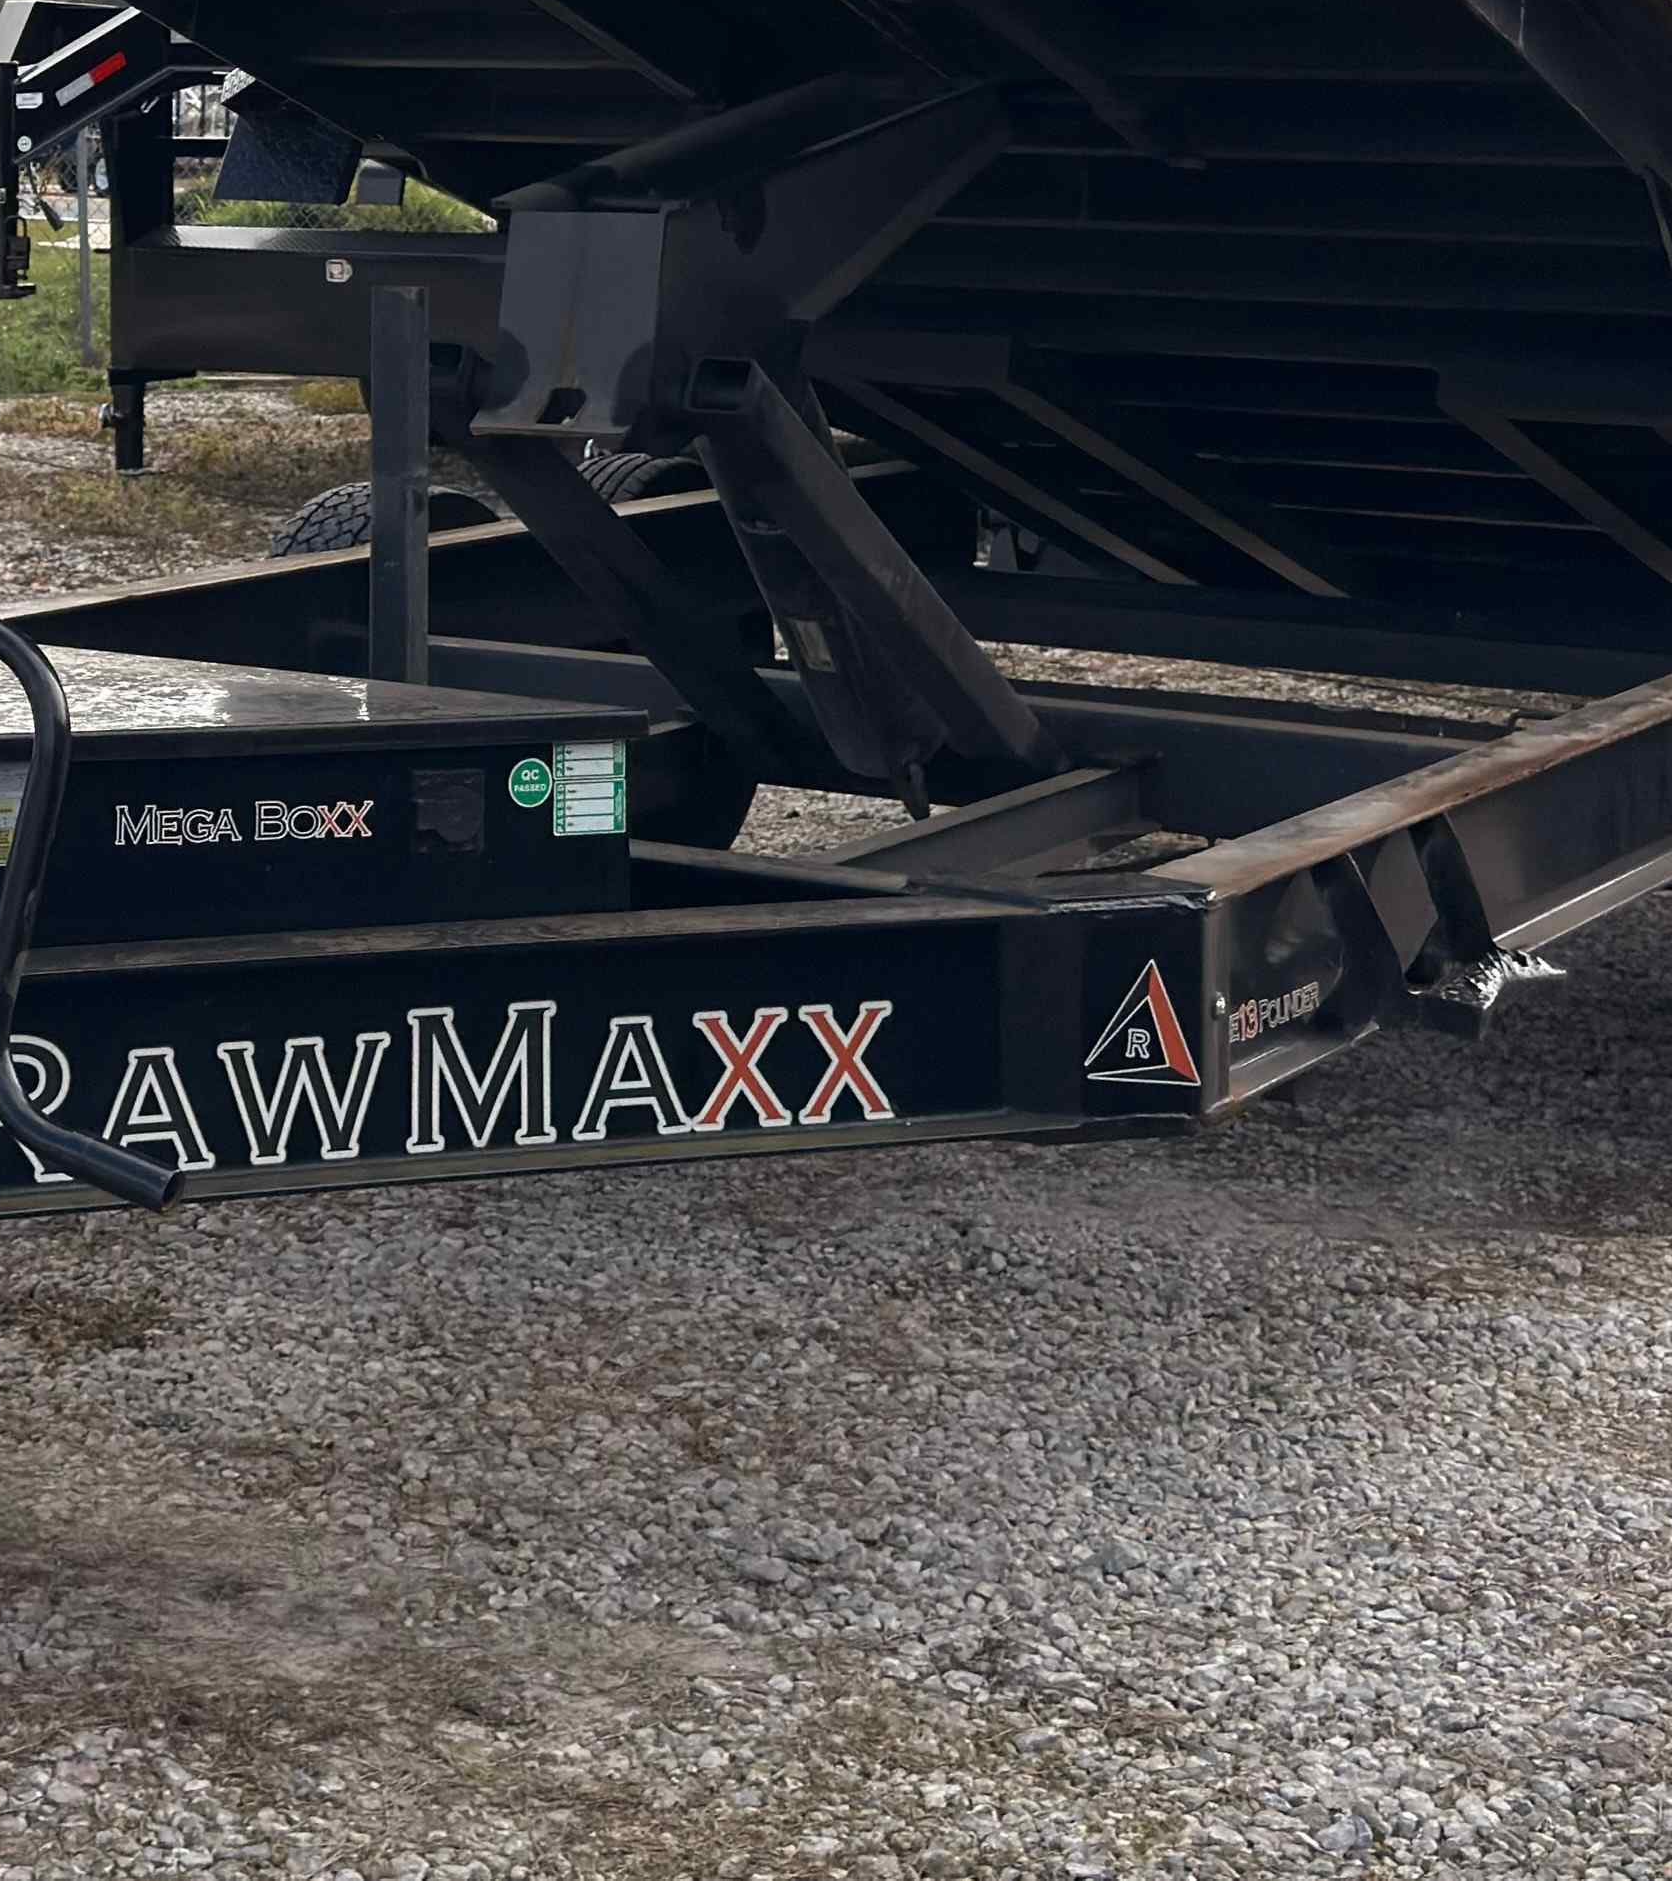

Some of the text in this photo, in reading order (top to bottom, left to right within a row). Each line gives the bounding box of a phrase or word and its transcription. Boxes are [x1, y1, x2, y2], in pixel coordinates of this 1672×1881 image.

[521, 769, 540, 781] QC
[514, 783, 546, 792] PASSED
[115, 800, 374, 845] MEGA BOXX
[1125, 1027, 1150, 1059] R
